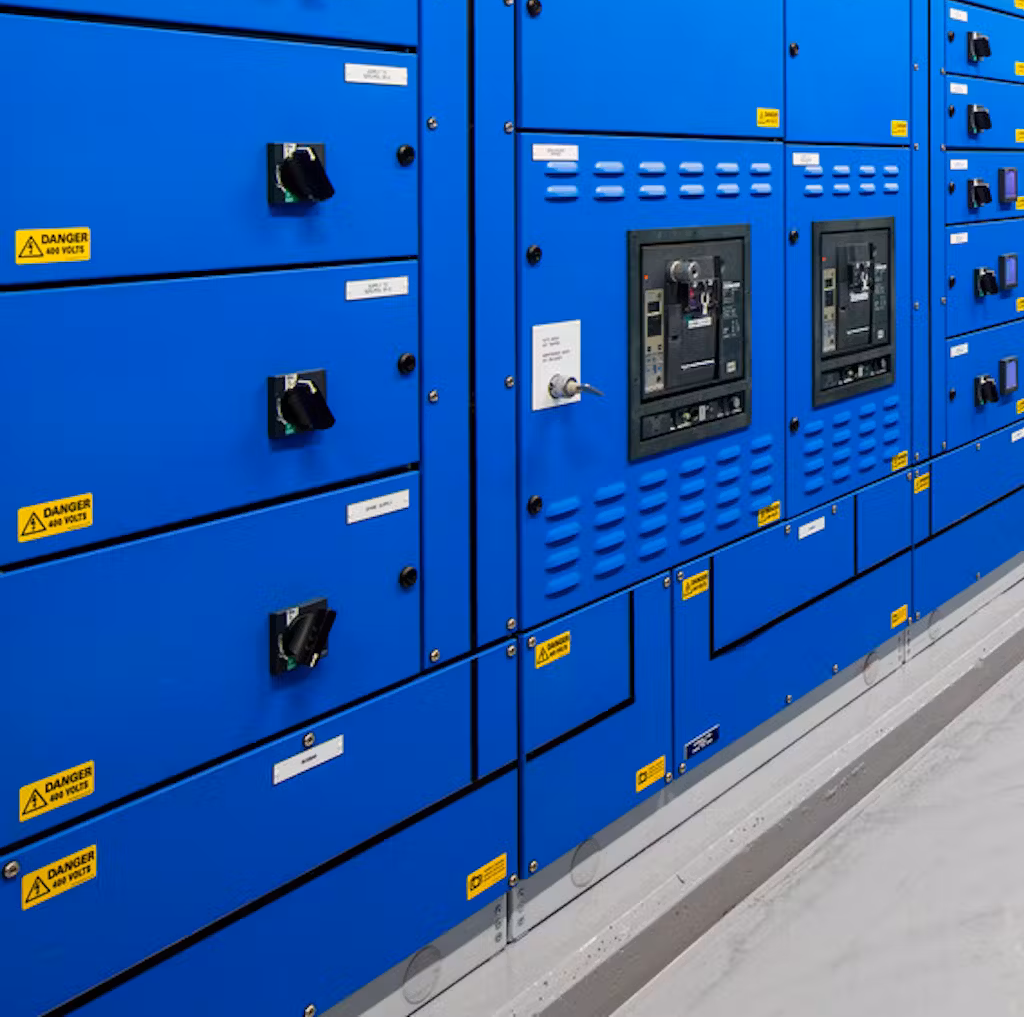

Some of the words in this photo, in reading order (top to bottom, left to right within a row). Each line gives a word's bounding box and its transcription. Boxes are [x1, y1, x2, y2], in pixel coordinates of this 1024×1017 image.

[41, 232, 88, 244] DANGER
[46, 247, 60, 255] 400
[61, 245, 85, 255] VOLTS
[43, 498, 91, 518] DANGER
[48, 518, 63, 528] 400
[63, 512, 87, 524] VOLTS
[45, 766, 92, 793] DANGER
[49, 790, 64, 802] 400
[65, 780, 89, 797] VOLTS
[47, 850, 95, 880] DANGER
[52, 876, 66, 889] 400
[68, 864, 91, 882] VOLTS
